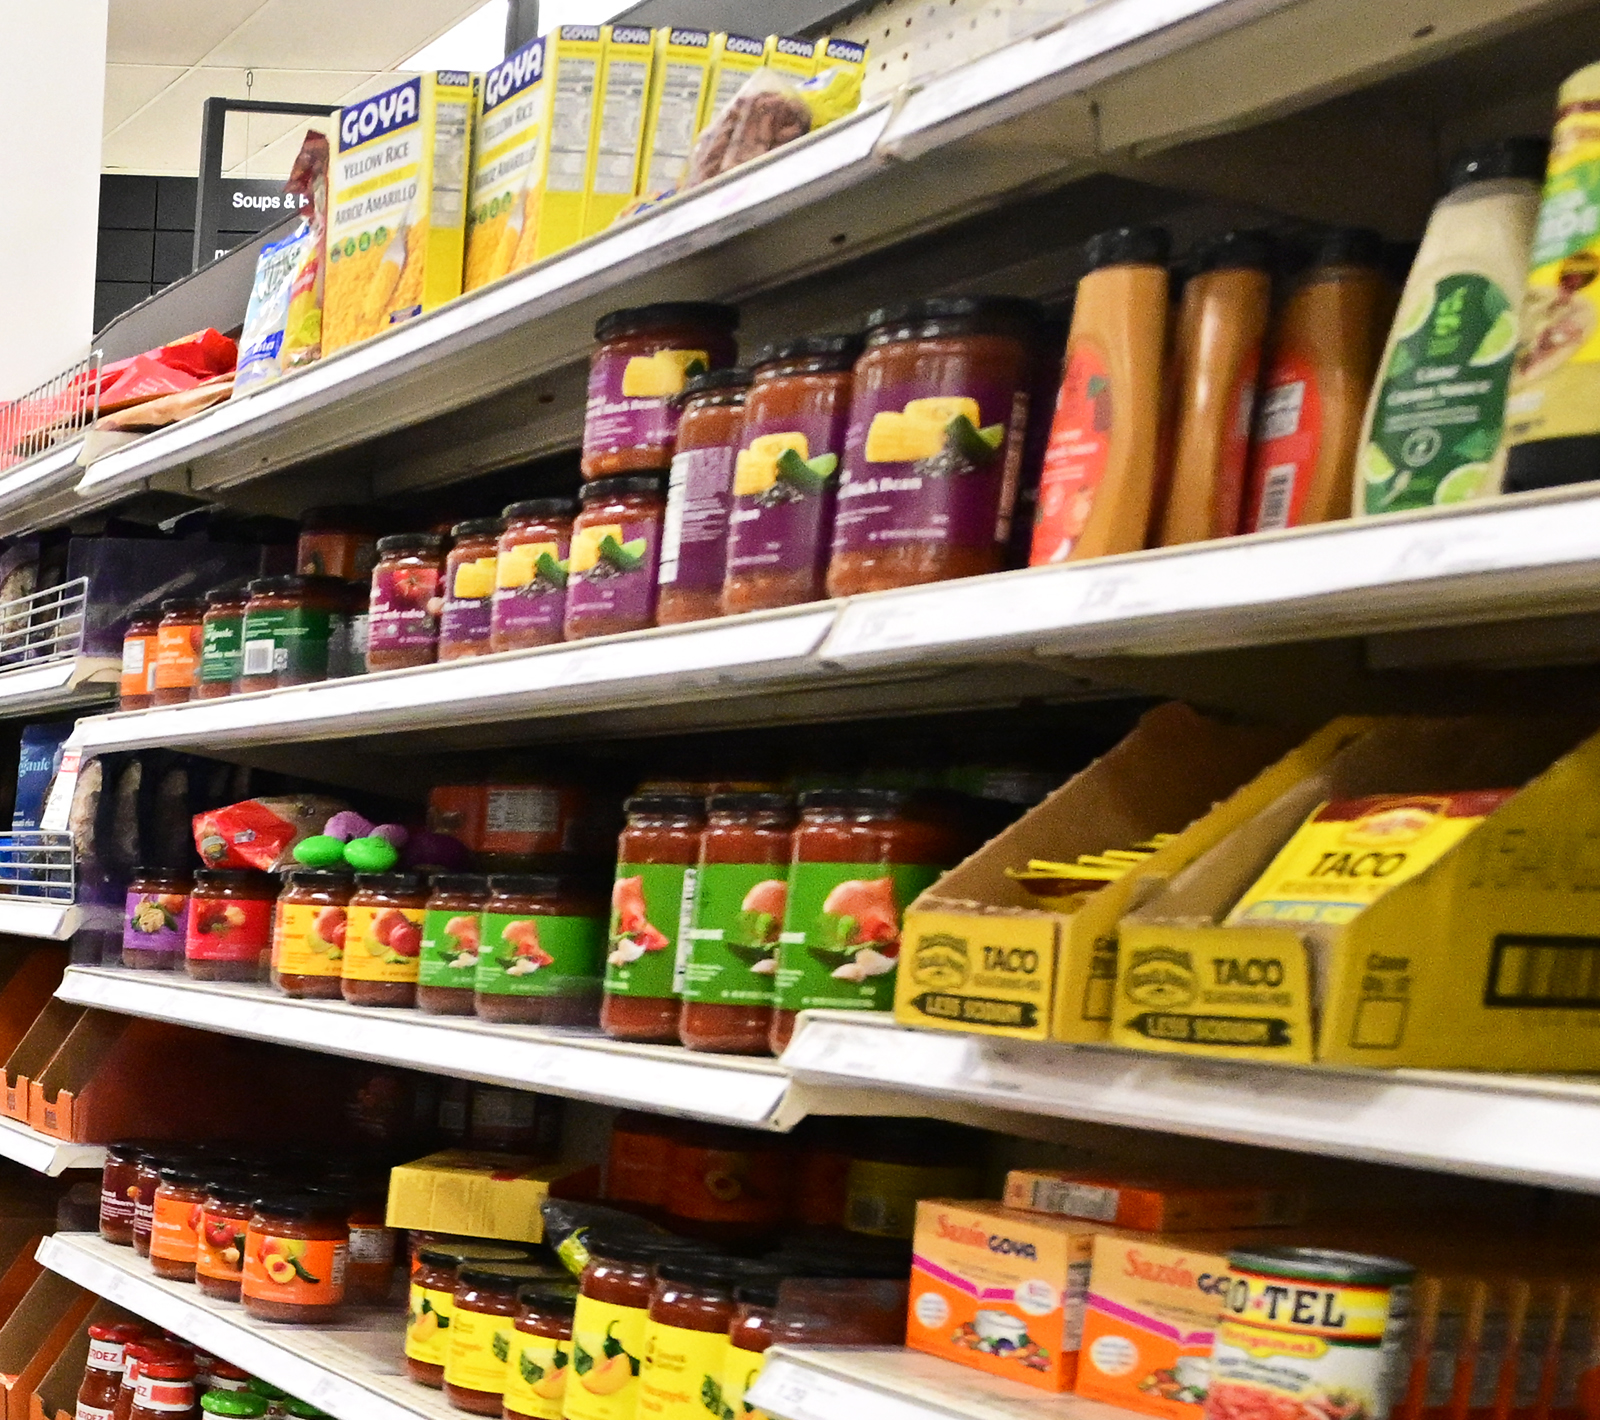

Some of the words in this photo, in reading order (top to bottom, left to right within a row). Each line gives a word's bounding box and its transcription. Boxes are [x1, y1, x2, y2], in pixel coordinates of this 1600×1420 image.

[486, 42, 544, 99] GOYA
[341, 86, 418, 145] GOYA
[232, 192, 281, 213] Soups
[283, 193, 296, 210] &
[1307, 851, 1408, 879] TACO
[981, 945, 1040, 974] TACO
[1212, 956, 1285, 988] TACO
[1122, 1248, 1197, 1289] Sazón
